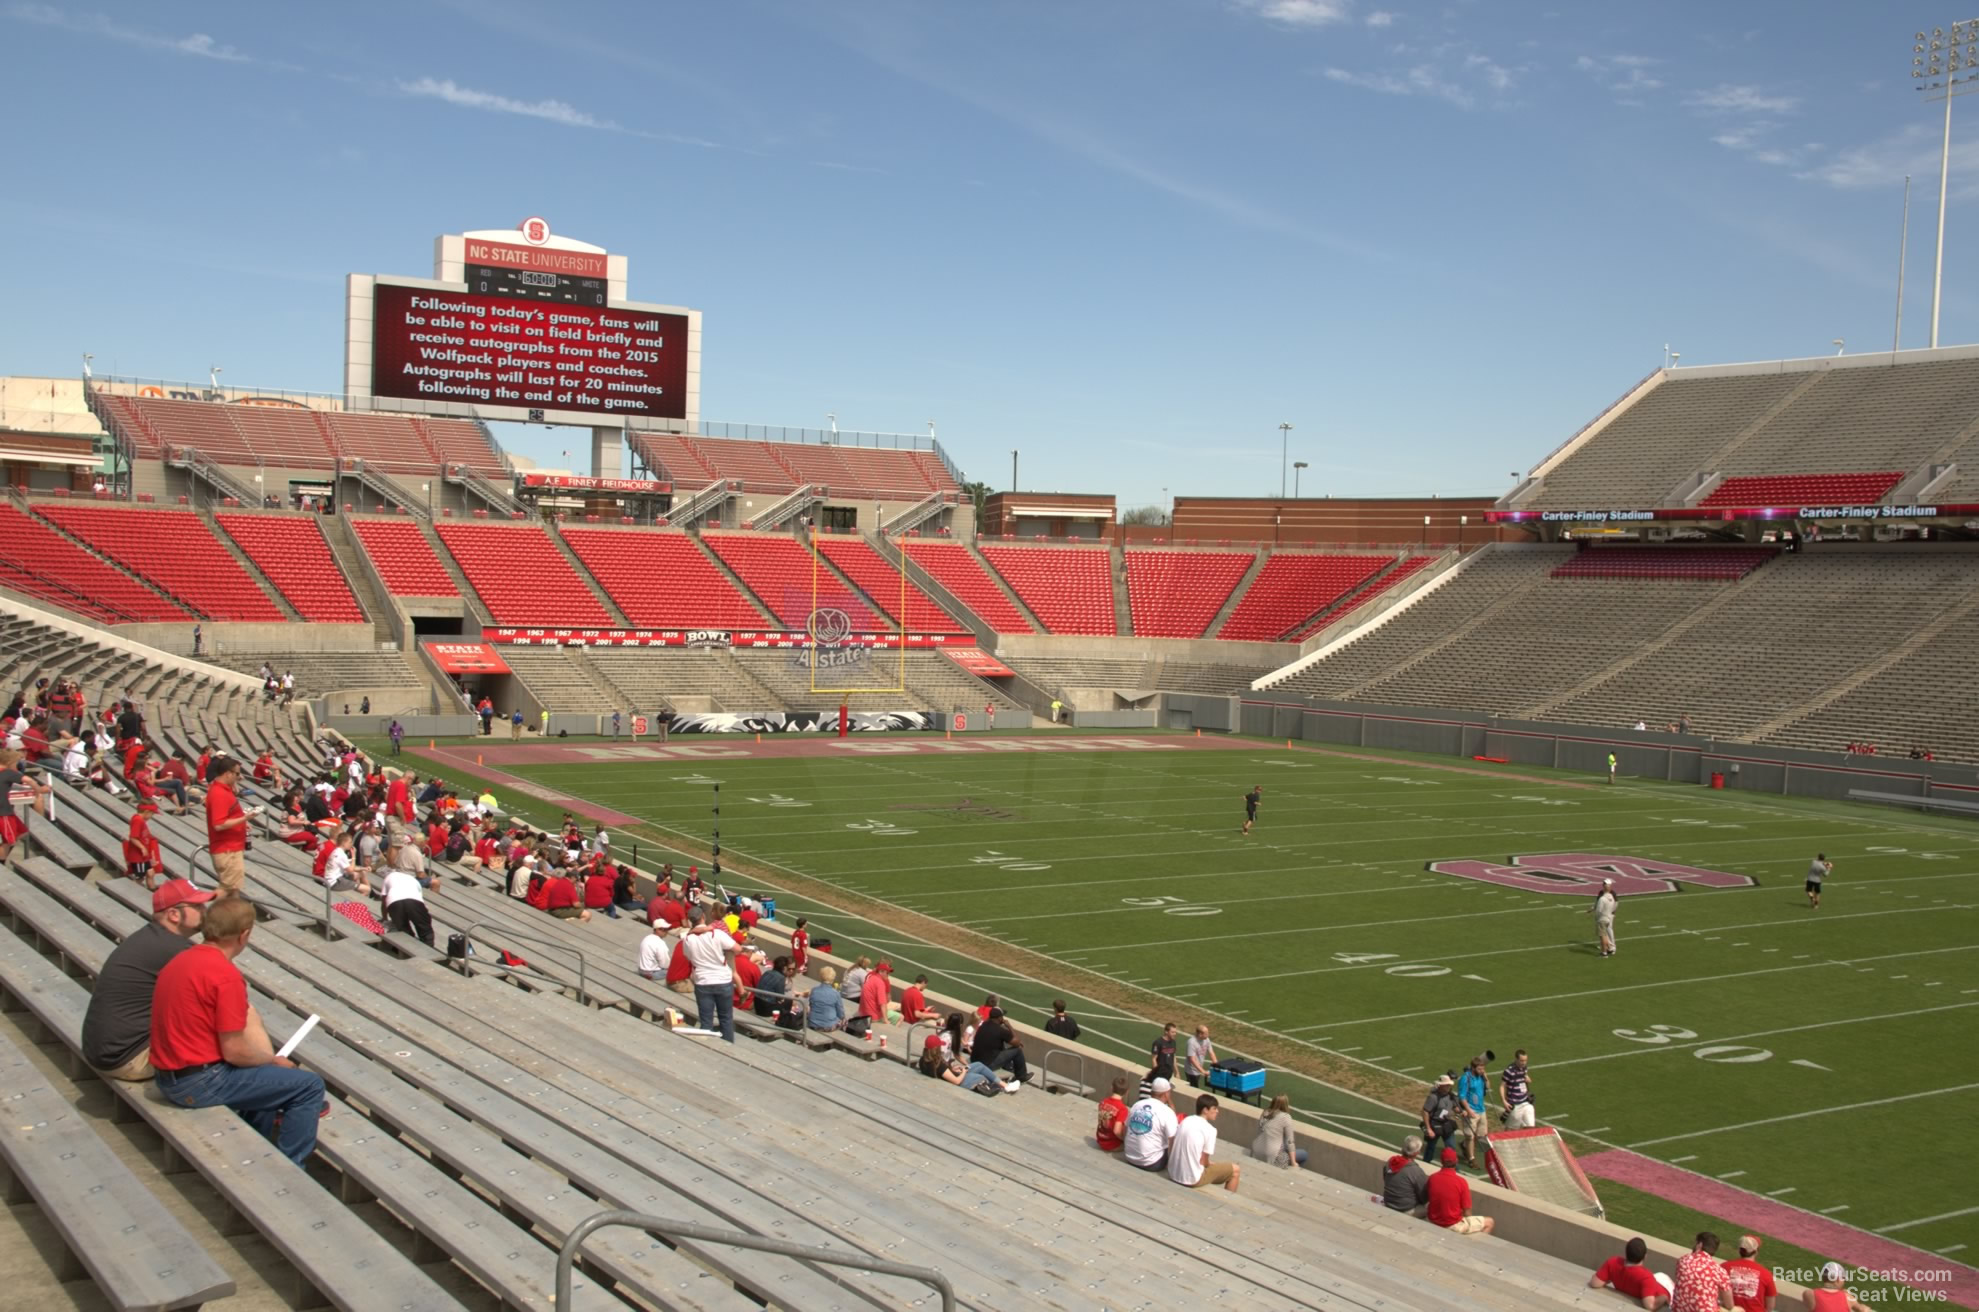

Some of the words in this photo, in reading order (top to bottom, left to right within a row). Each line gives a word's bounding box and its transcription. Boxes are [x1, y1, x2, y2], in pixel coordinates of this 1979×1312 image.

[470, 244, 488, 259] NC
[491, 247, 529, 264] STATE
[531, 253, 603, 272] UNIVERSITY
[480, 269, 491, 277] RED
[524, 272, 555, 286] 60:00
[480, 282, 487, 292] 0
[582, 280, 600, 289] WHITE
[596, 294, 602, 304] 0
[411, 296, 486, 317] Following
[549, 314, 595, 328] game,
[599, 315, 630, 329] fans
[634, 320, 659, 332] will
[406, 312, 426, 325] be
[430, 316, 465, 329] able
[470, 320, 485, 331] to
[490, 322, 520, 334] visit
[525, 327, 544, 336] on
[549, 326, 582, 340] field
[586, 330, 632, 347] briefly
[636, 337, 662, 348] and
[410, 333, 465, 345] receive
[470, 338, 554, 354] autographs
[559, 344, 593, 357] from
[598, 347, 621, 360] the
[626, 350, 659, 362] 2015
[420, 348, 493, 365] Wolfpack
[498, 355, 551, 370] players
[556, 361, 584, 372] and
[588, 364, 649, 378] coaches.
[403, 363, 492, 381] Autographs
[496, 371, 522, 383] will
[528, 373, 555, 385] last
[560, 376, 580, 388] for
[585, 378, 603, 390] 20
[608, 382, 663, 394] minutes
[418, 380, 490, 400] following
[496, 386, 520, 399] the
[524, 390, 552, 401] end
[557, 392, 573, 402] of
[576, 393, 600, 405] the
[604, 398, 649, 409] game.
[530, 410, 544, 420] 25
[568, 478, 598, 488] FINLEY
[602, 480, 654, 490] FIELDHOUSE
[1542, 511, 1607, 522] Carter-Finley
[1610, 510, 1654, 520] Stadium
[1800, 506, 1879, 519] Carter-Finley
[1882, 506, 1937, 517] Stadium
[688, 631, 730, 642] BOWL
[884, 634, 900, 642] 1991
[826, 738, 1186, 753] STATE
[845, 822, 920, 836] 30
[968, 856, 1053, 871] 40
[1122, 896, 1224, 917] 50
[794, 937, 800, 950] 8
[1330, 952, 1453, 977] 40
[1612, 1024, 1774, 1064] 30
